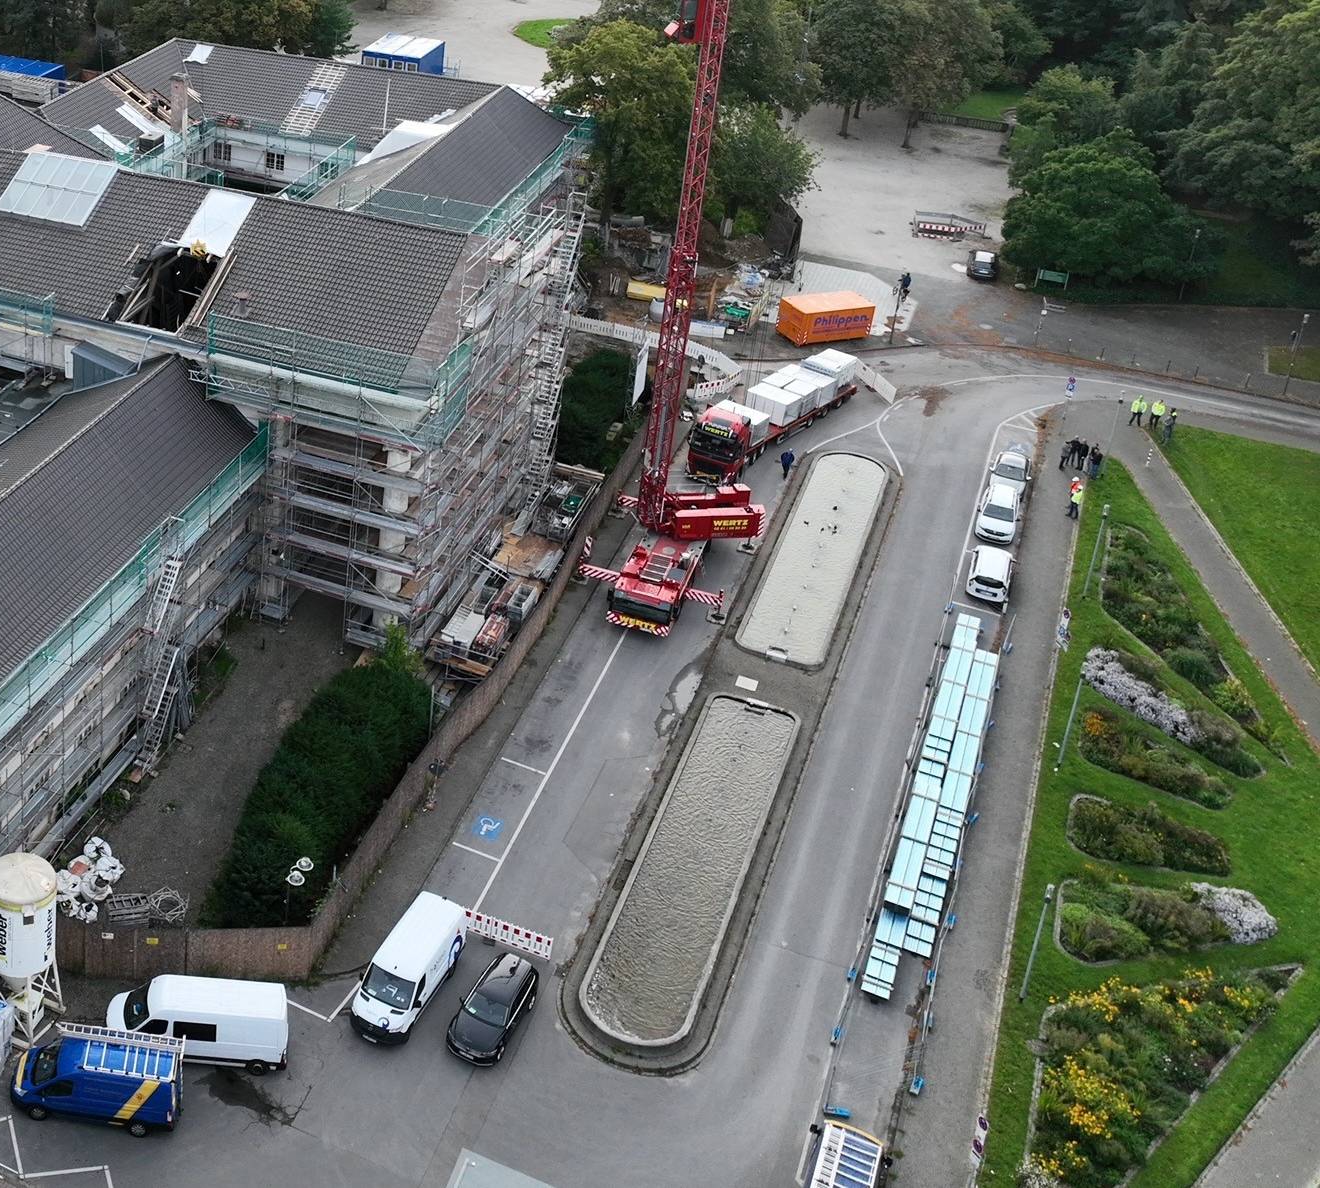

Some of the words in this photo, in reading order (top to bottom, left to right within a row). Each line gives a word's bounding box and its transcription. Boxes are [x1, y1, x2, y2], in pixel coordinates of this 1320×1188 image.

[814, 314, 869, 327] Philippen
[705, 426, 728, 436] WERTZ
[619, 615, 656, 630] WERTZ
